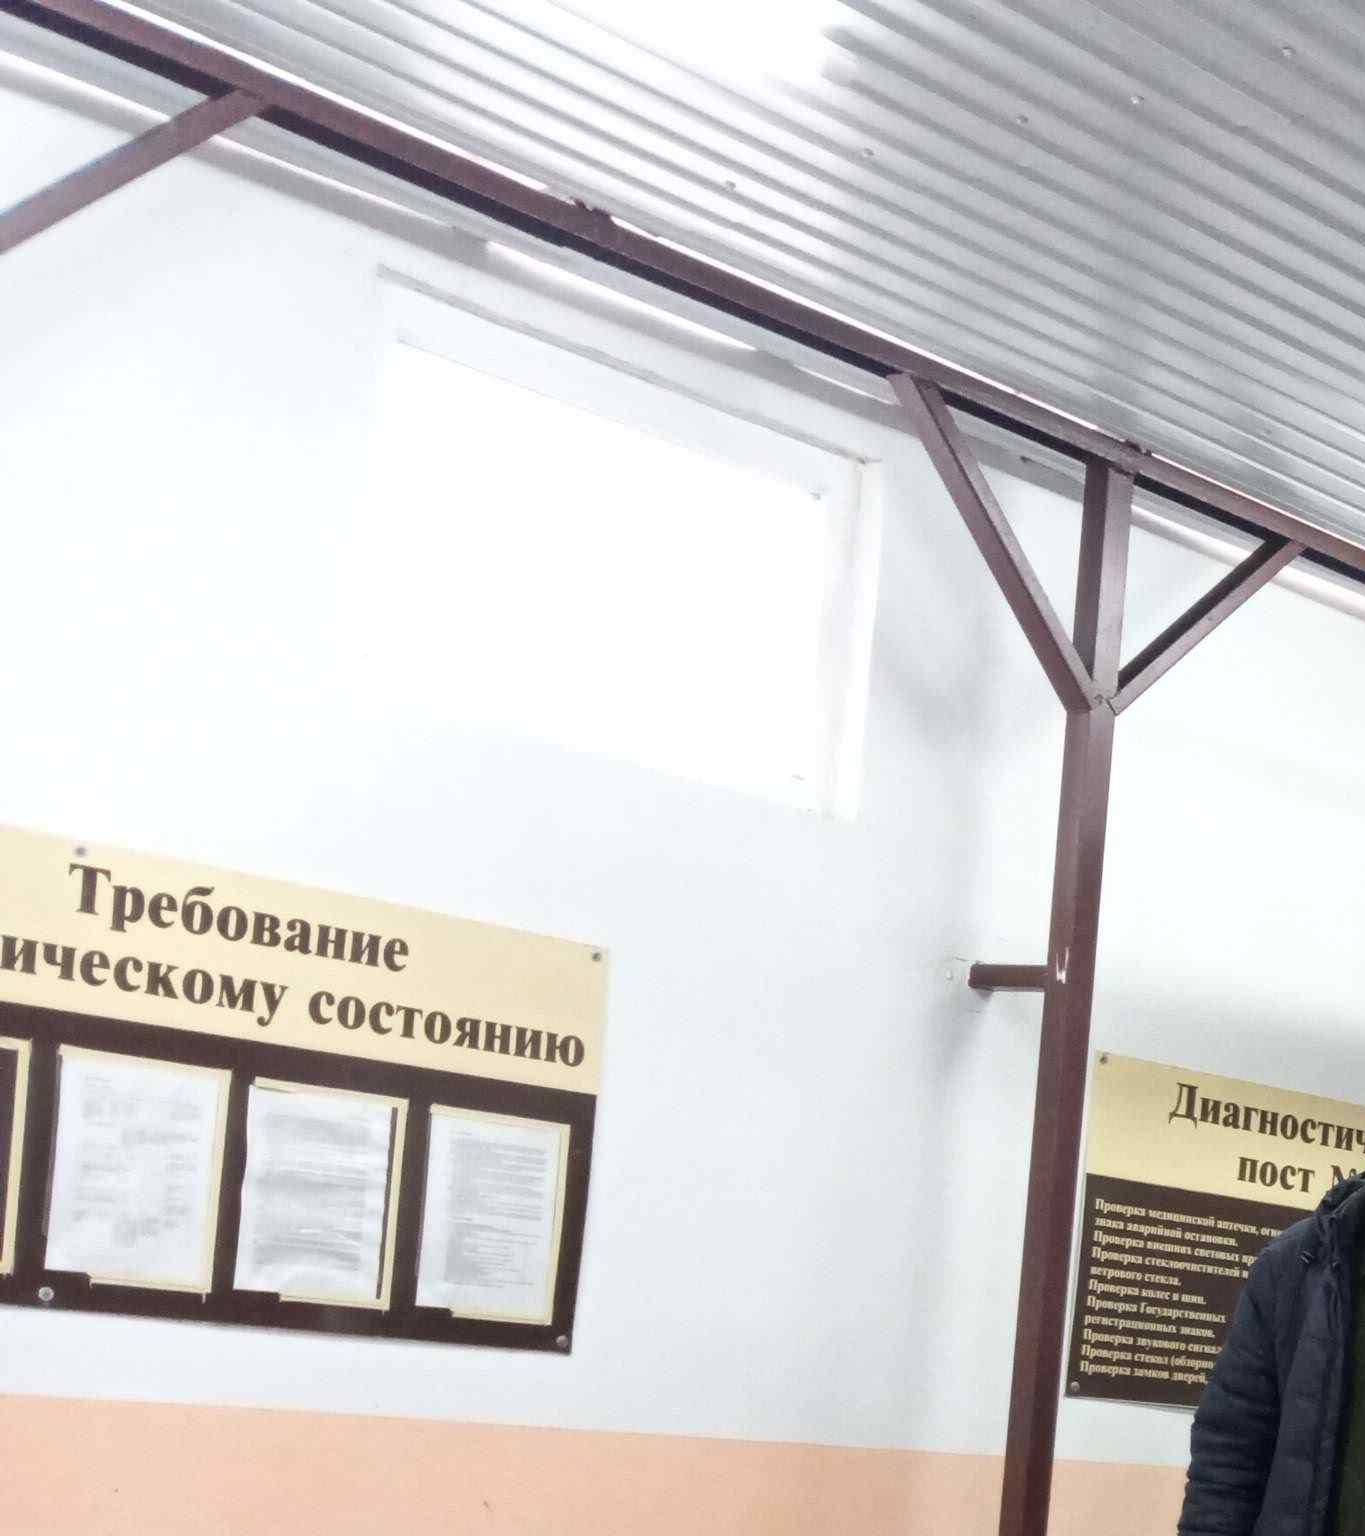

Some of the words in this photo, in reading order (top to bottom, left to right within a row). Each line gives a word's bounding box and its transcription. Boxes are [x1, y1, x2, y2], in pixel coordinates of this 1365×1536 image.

[69, 863, 410, 972] Требование
[0, 934, 288, 1027] ическому
[308, 990, 585, 1067] состоянию
[1237, 1156, 1315, 1193] пост
[1095, 1198, 1145, 1217] Проверка
[1093, 1230, 1144, 1249] Проверка
[1091, 1246, 1142, 1265] Проверка
[1088, 1278, 1139, 1297] Проверка
[1086, 1296, 1137, 1314] Проверка
[1083, 1328, 1134, 1347] Проверка
[1081, 1345, 1132, 1363] Проверка
[1079, 1360, 1131, 1378] Проверка
